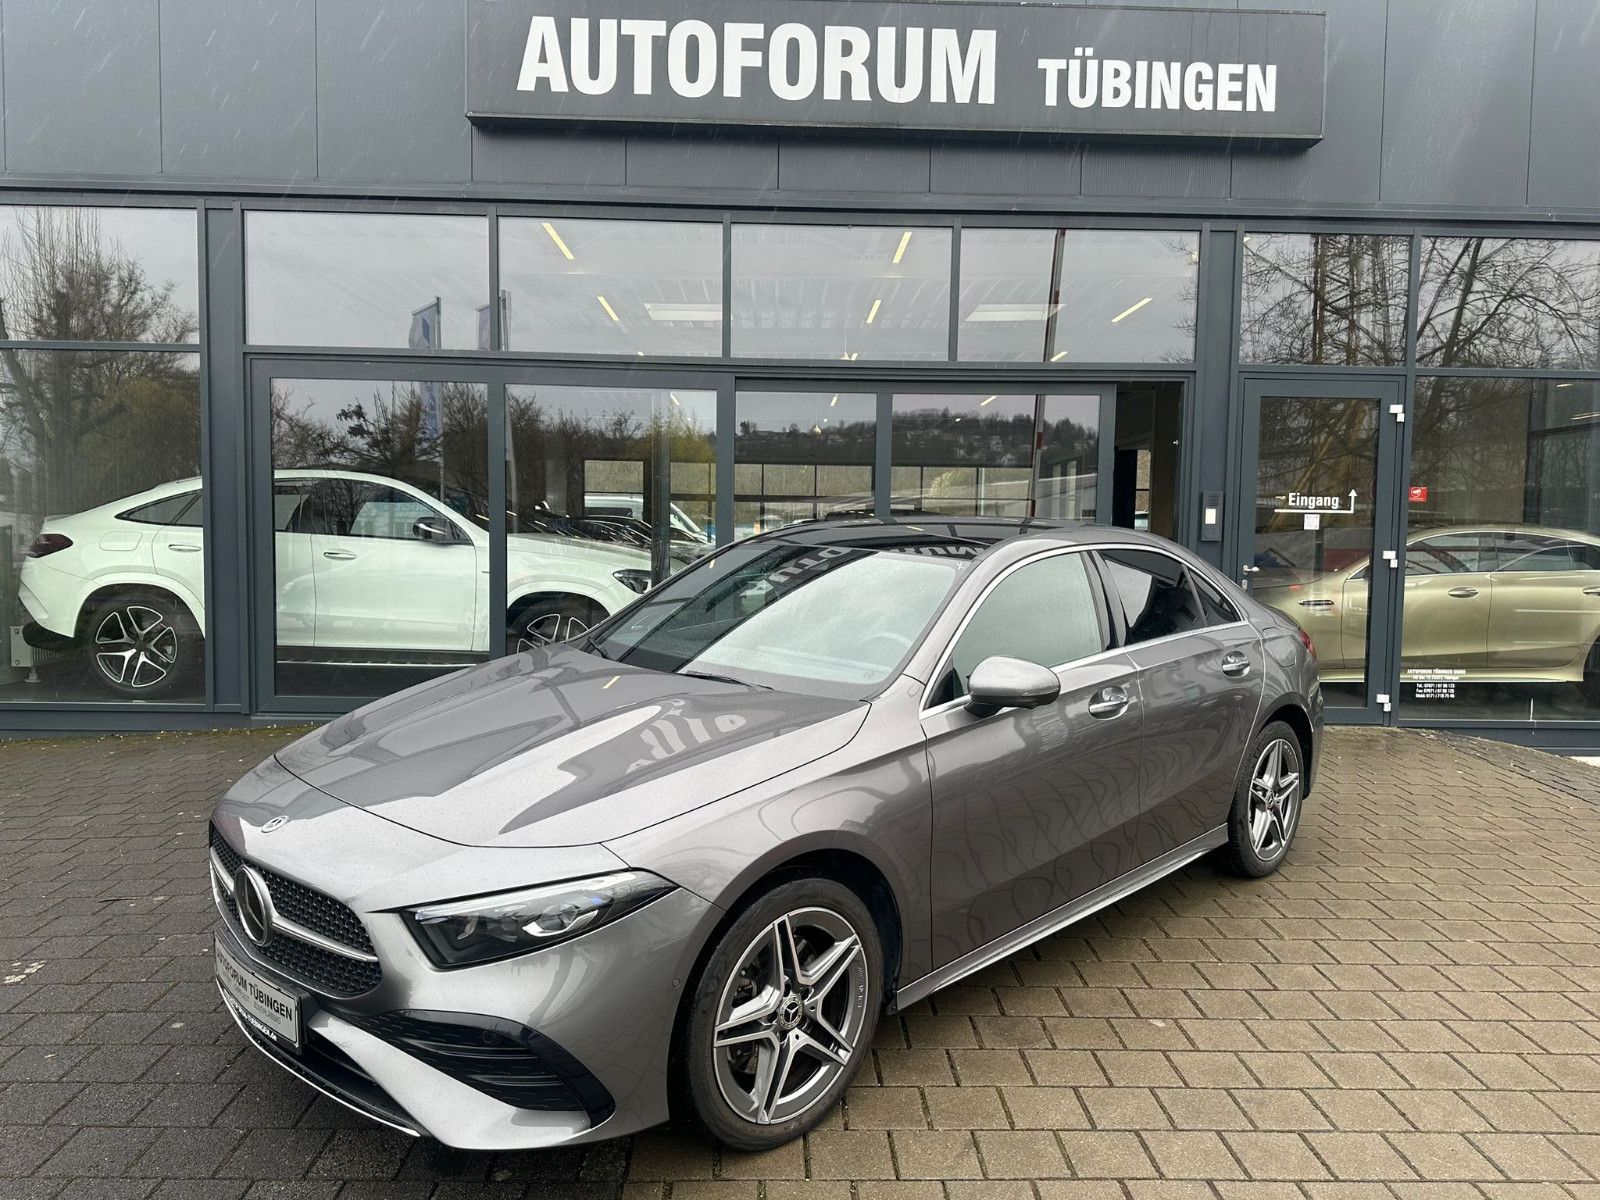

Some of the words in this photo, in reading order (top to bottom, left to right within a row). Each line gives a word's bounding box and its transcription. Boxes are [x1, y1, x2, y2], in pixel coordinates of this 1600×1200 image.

[516, 16, 997, 104] AUTOFORUM
[1037, 47, 1277, 112] TÜBINGEN
[1288, 492, 1340, 509] Eingang
[248, 982, 293, 1021] TÜBINGEN
